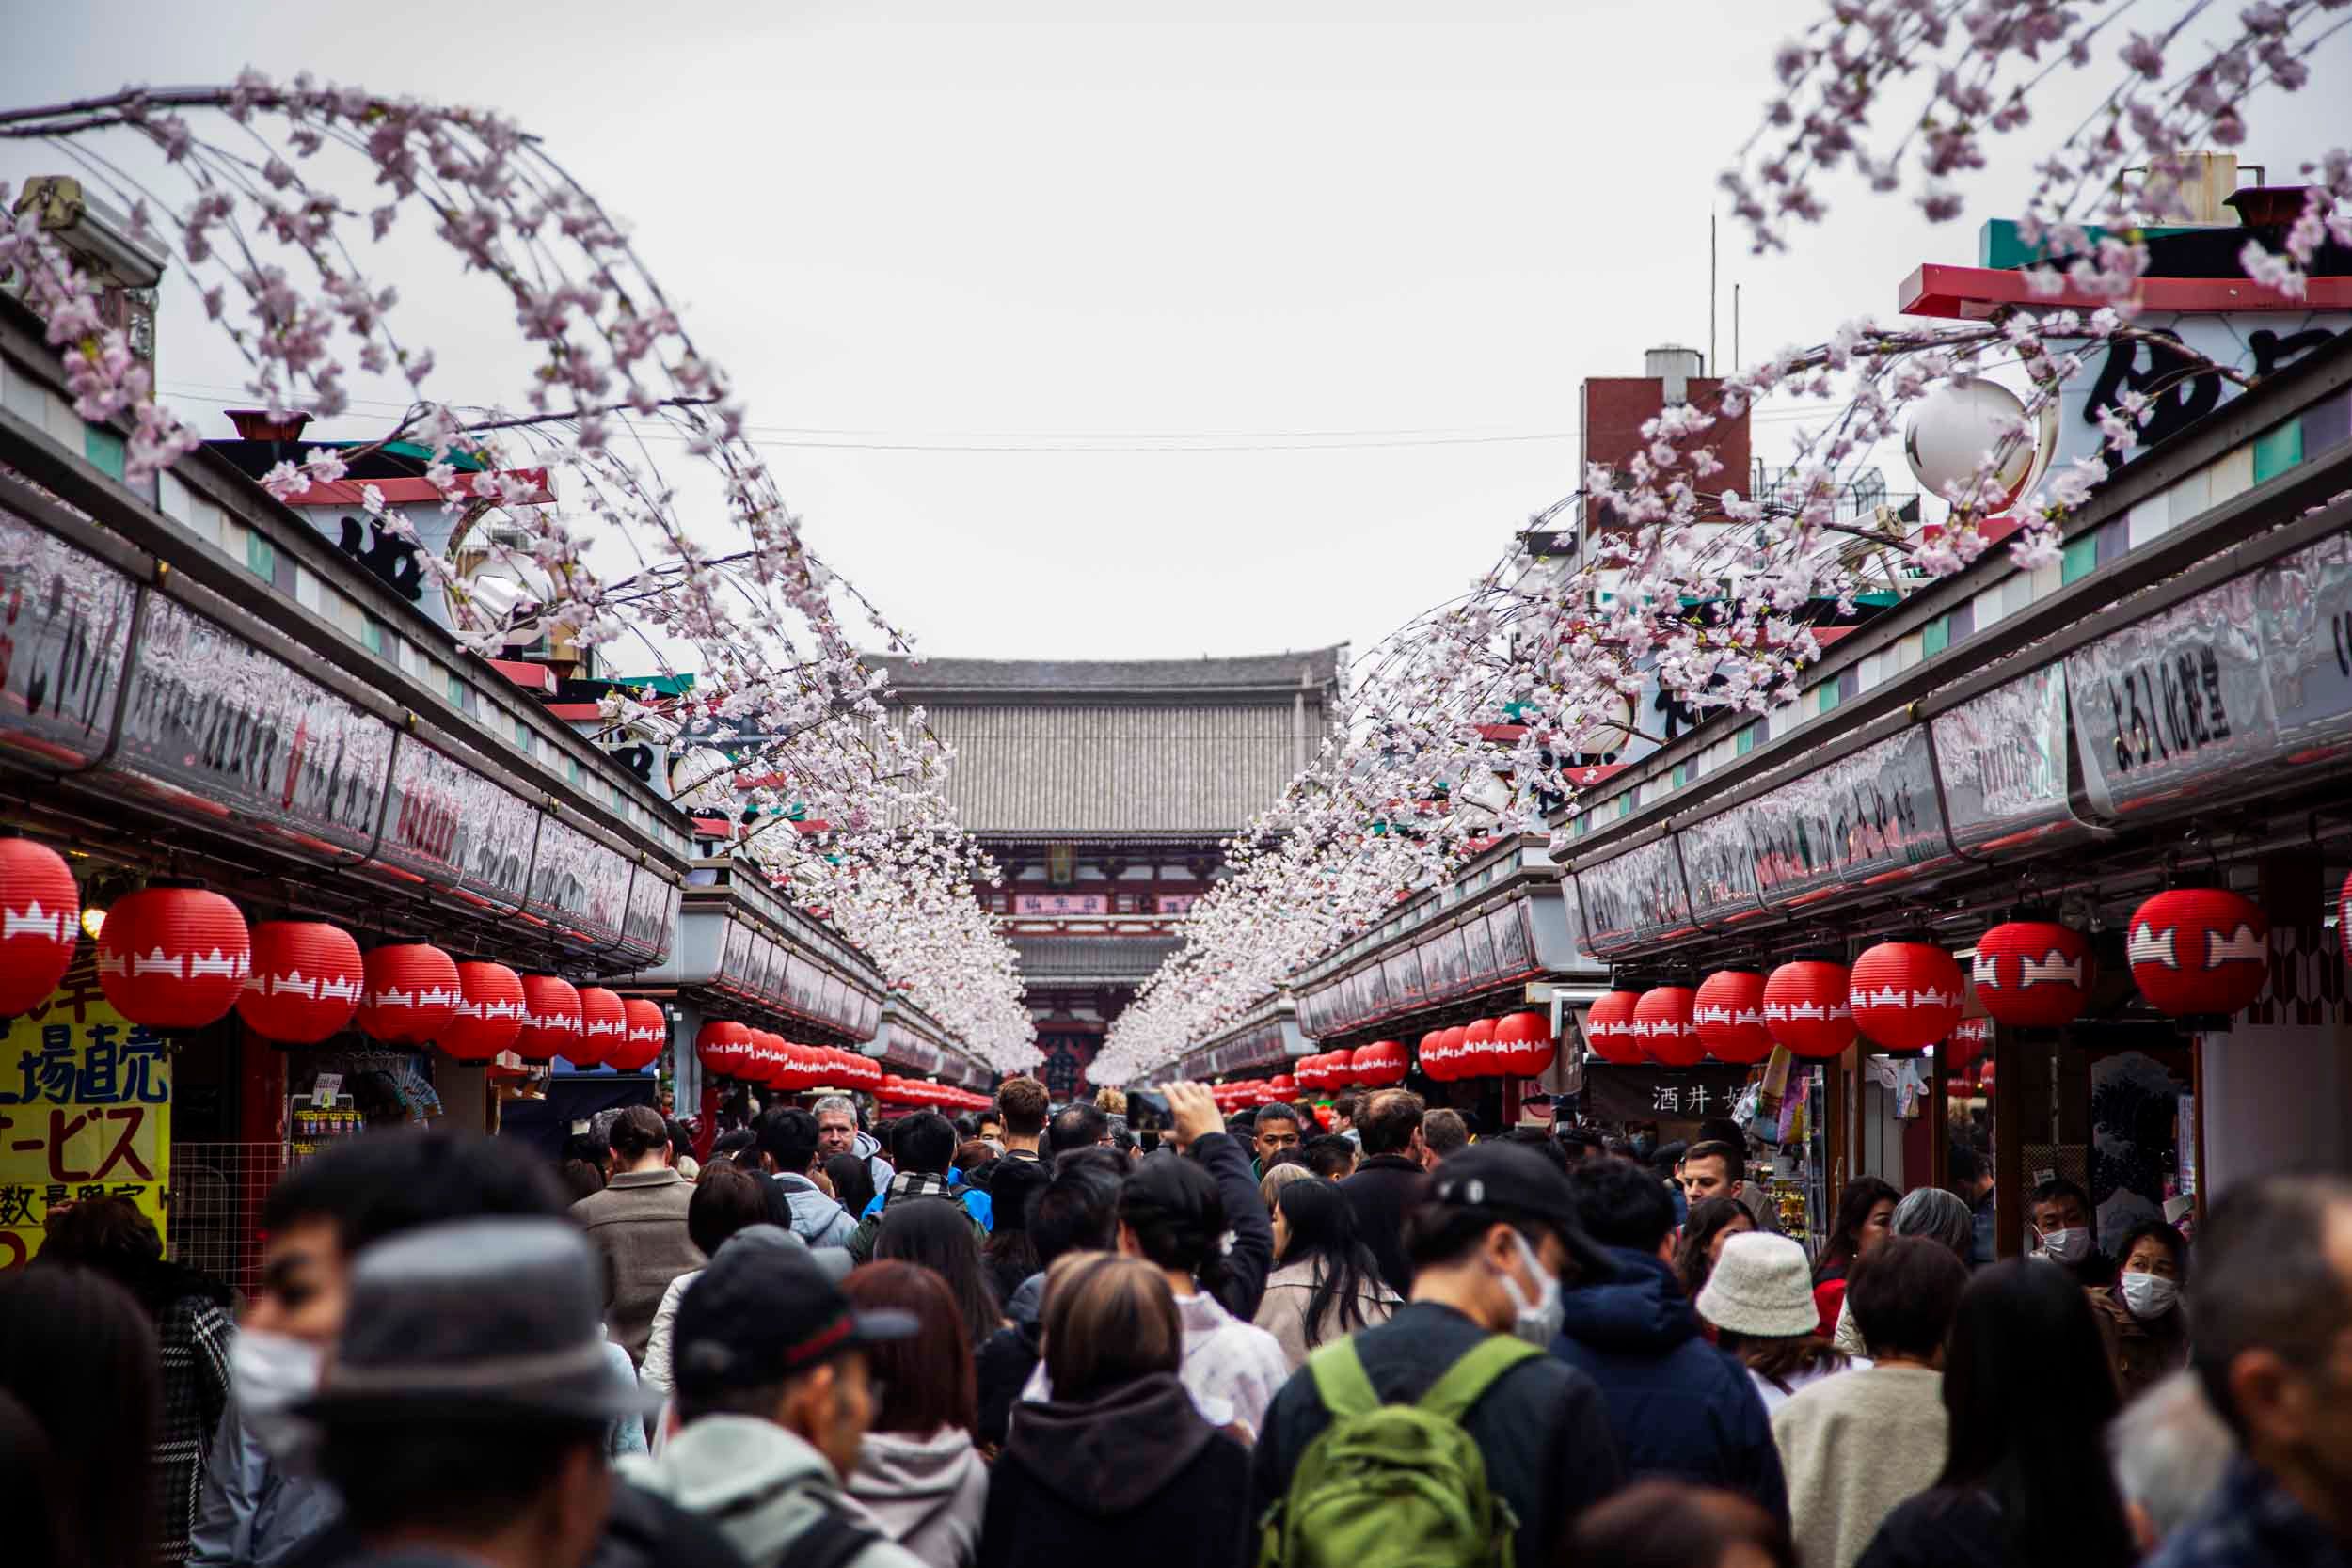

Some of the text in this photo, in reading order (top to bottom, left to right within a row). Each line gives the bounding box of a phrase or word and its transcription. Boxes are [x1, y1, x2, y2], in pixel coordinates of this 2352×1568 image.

[2108, 645, 2230, 772] よろし化粧堂
[0, 1023, 168, 1104] 場直売
[0, 1106, 153, 1181] ービス
